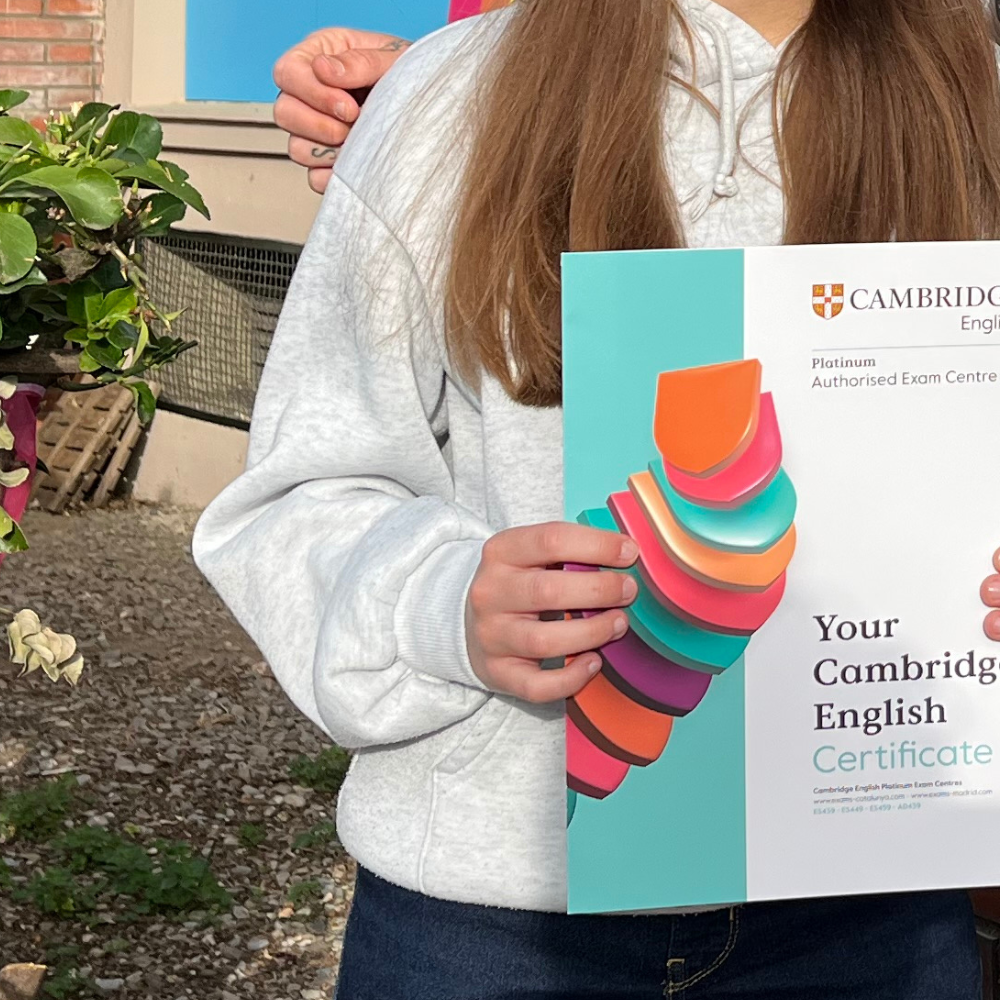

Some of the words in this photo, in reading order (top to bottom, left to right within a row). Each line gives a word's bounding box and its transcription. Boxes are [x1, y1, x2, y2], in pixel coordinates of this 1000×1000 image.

[812, 357, 876, 369] Platinum
[811, 373, 897, 388] Authorised
[902, 371, 941, 384] Exam
[945, 370, 998, 383] Centre
[813, 614, 900, 642] Your
[813, 696, 947, 736] English
[812, 740, 993, 773] Certificate
[813, 785, 854, 794] Cambridge
[855, 783, 880, 793] English
[881, 782, 913, 790] Platinum
[934, 780, 963, 788] Centres
